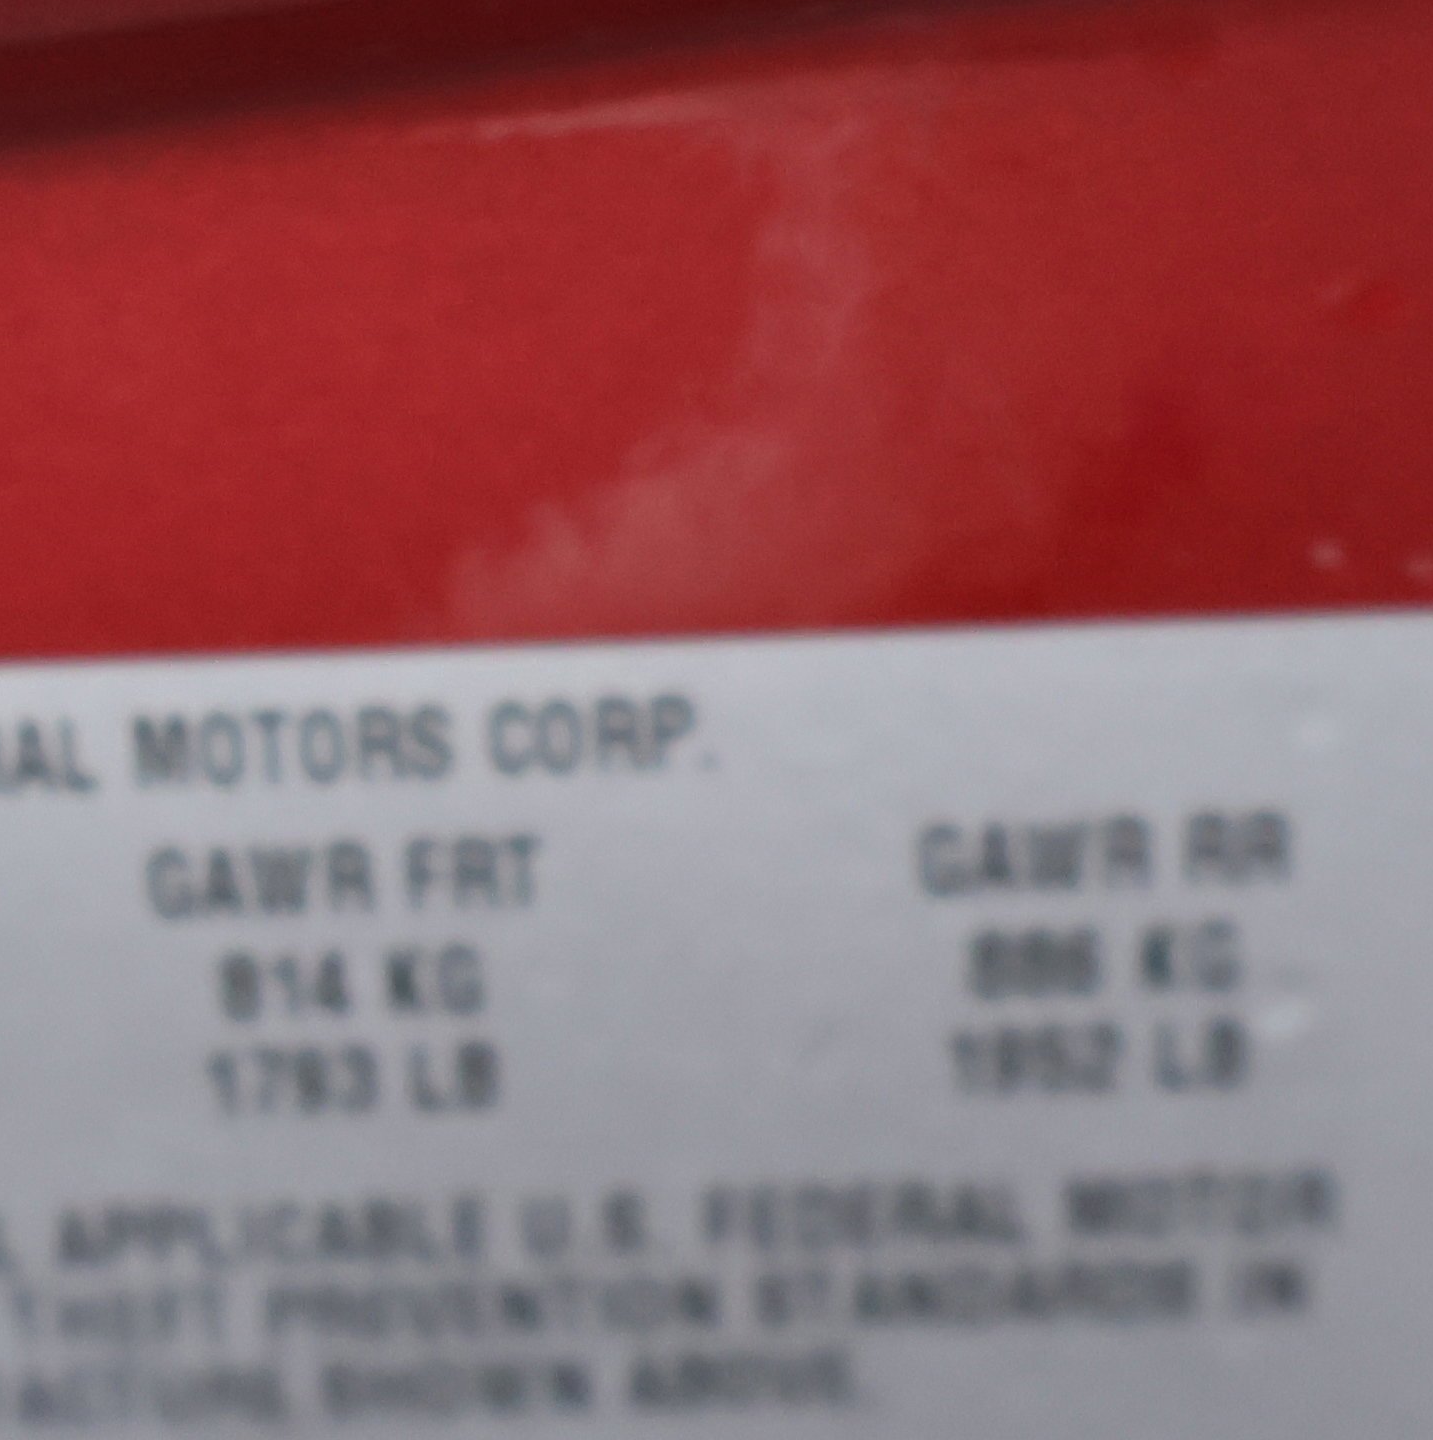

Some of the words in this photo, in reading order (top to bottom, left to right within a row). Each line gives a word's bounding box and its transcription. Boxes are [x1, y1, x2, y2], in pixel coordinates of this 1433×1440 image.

[130, 703, 454, 792] MOTORS
[487, 692, 720, 777] CORP.
[144, 840, 377, 922] GAWR
[402, 830, 542, 912] FRT
[917, 810, 1154, 900] GAWR
[1182, 805, 1292, 885] RR
[219, 948, 354, 1023] 814
[384, 940, 487, 1018] KG
[1137, 915, 1242, 995] KG
[407, 1038, 502, 1115] LB
[1150, 1015, 1250, 1093] LB
[54, 1190, 484, 1272] APPLICABLE
[702, 1175, 1030, 1255] FEDERAL
[1062, 1165, 1344, 1240] MOTOR
[262, 1270, 722, 1350] PREVENTION
